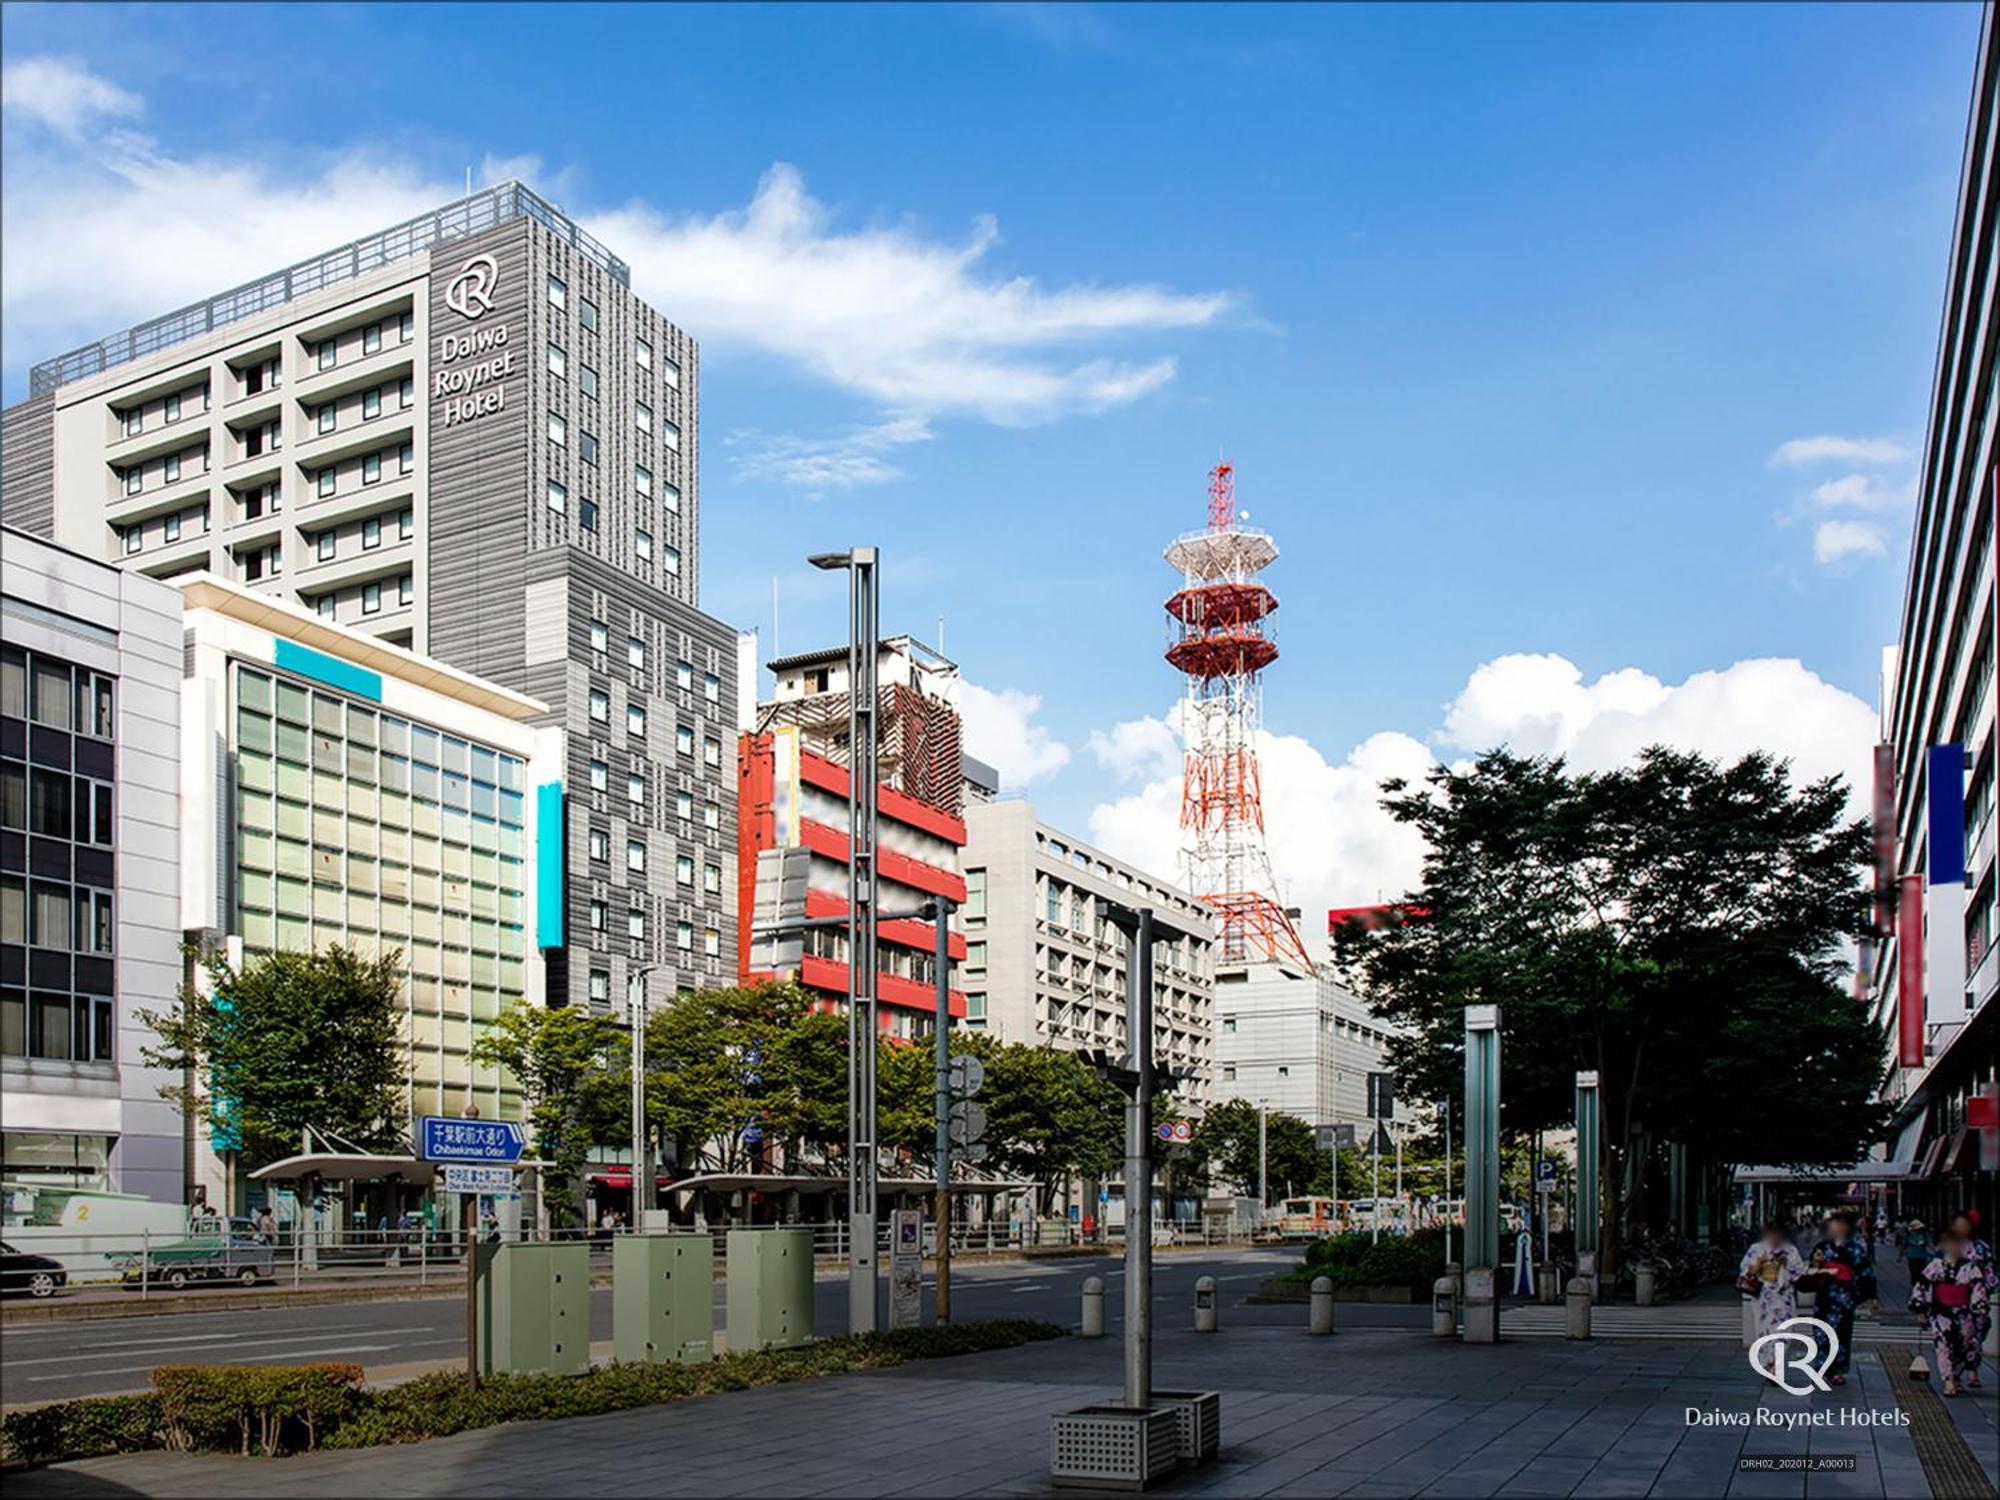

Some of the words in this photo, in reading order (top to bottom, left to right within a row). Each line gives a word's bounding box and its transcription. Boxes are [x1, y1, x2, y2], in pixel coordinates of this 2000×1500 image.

[441, 324, 509, 363] Daiwa
[435, 351, 515, 398] Roynet
[444, 384, 505, 427] Hotel
[434, 1125, 505, 1146] 千葉駅前大通り
[1540, 1162, 1553, 1177] P
[78, 1205, 88, 1220] 2
